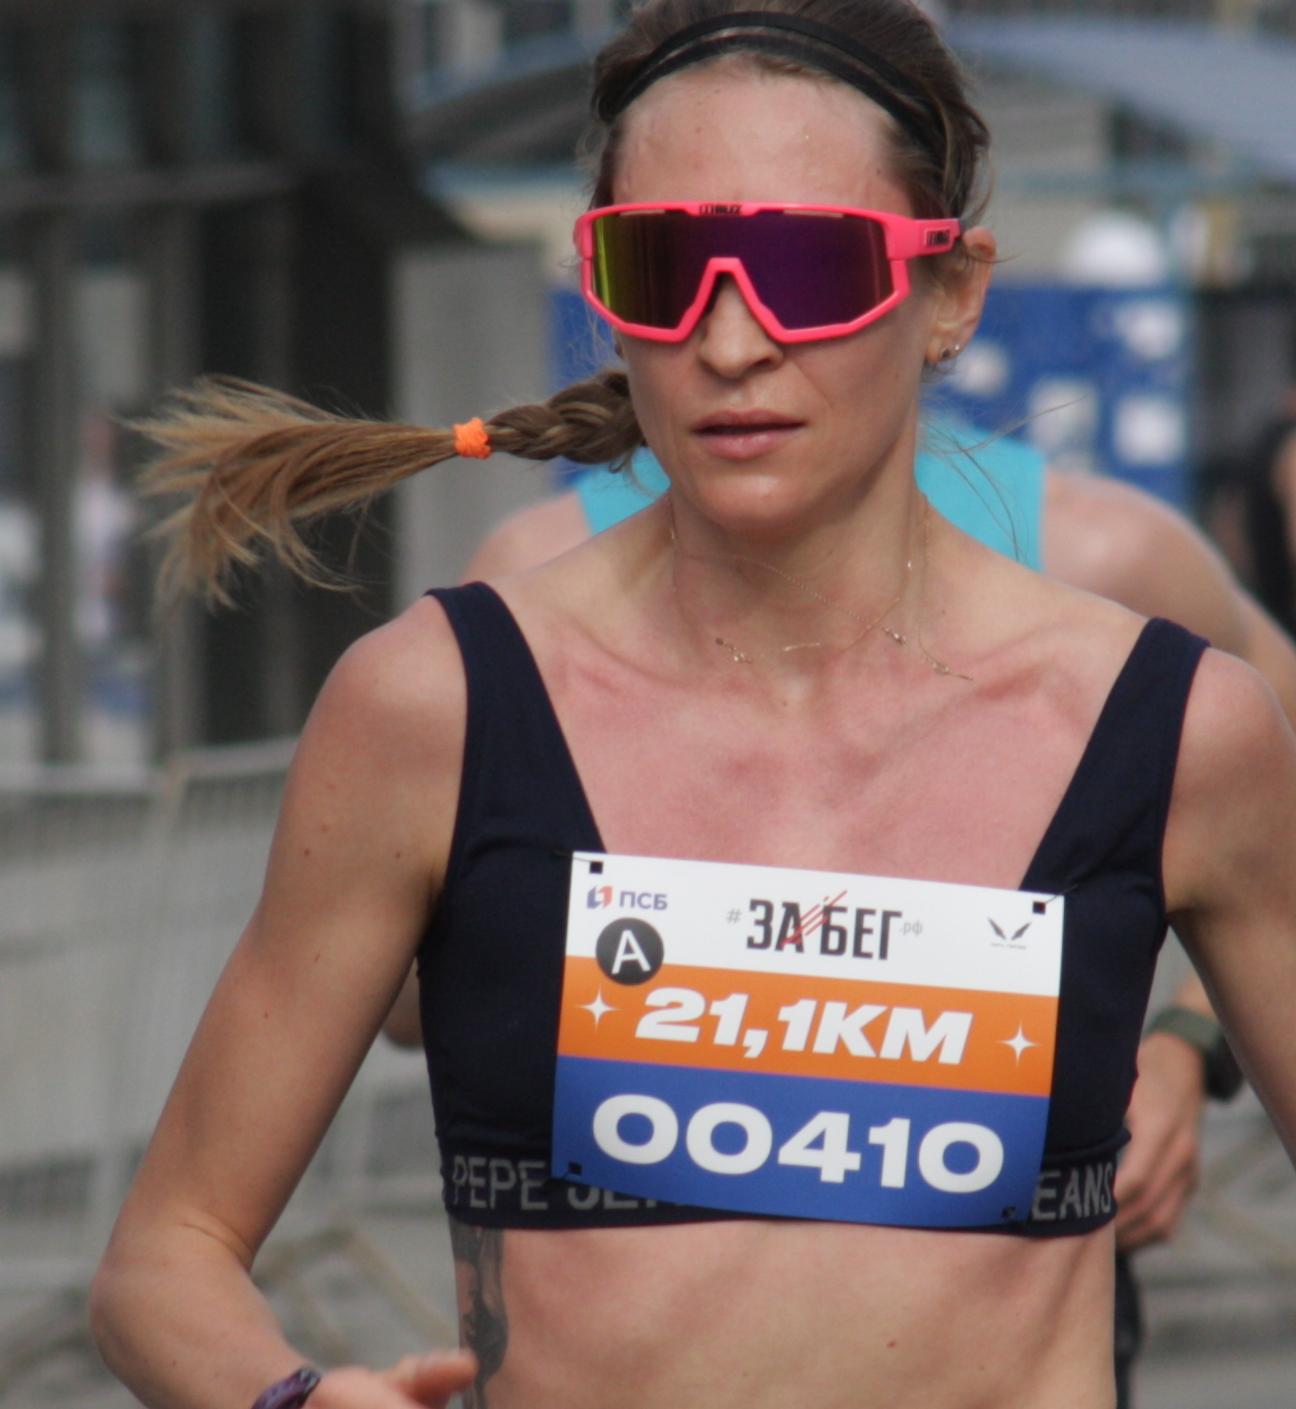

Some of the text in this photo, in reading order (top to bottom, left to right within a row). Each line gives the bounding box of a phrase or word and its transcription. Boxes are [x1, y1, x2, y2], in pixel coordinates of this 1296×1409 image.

[619, 889, 668, 911] ПСБ
[634, 985, 973, 1065] 21,1КМ
[592, 1093, 1005, 1194] 00410
[453, 1154, 549, 1211] PEPE
[1031, 1162, 1113, 1219] EANS
